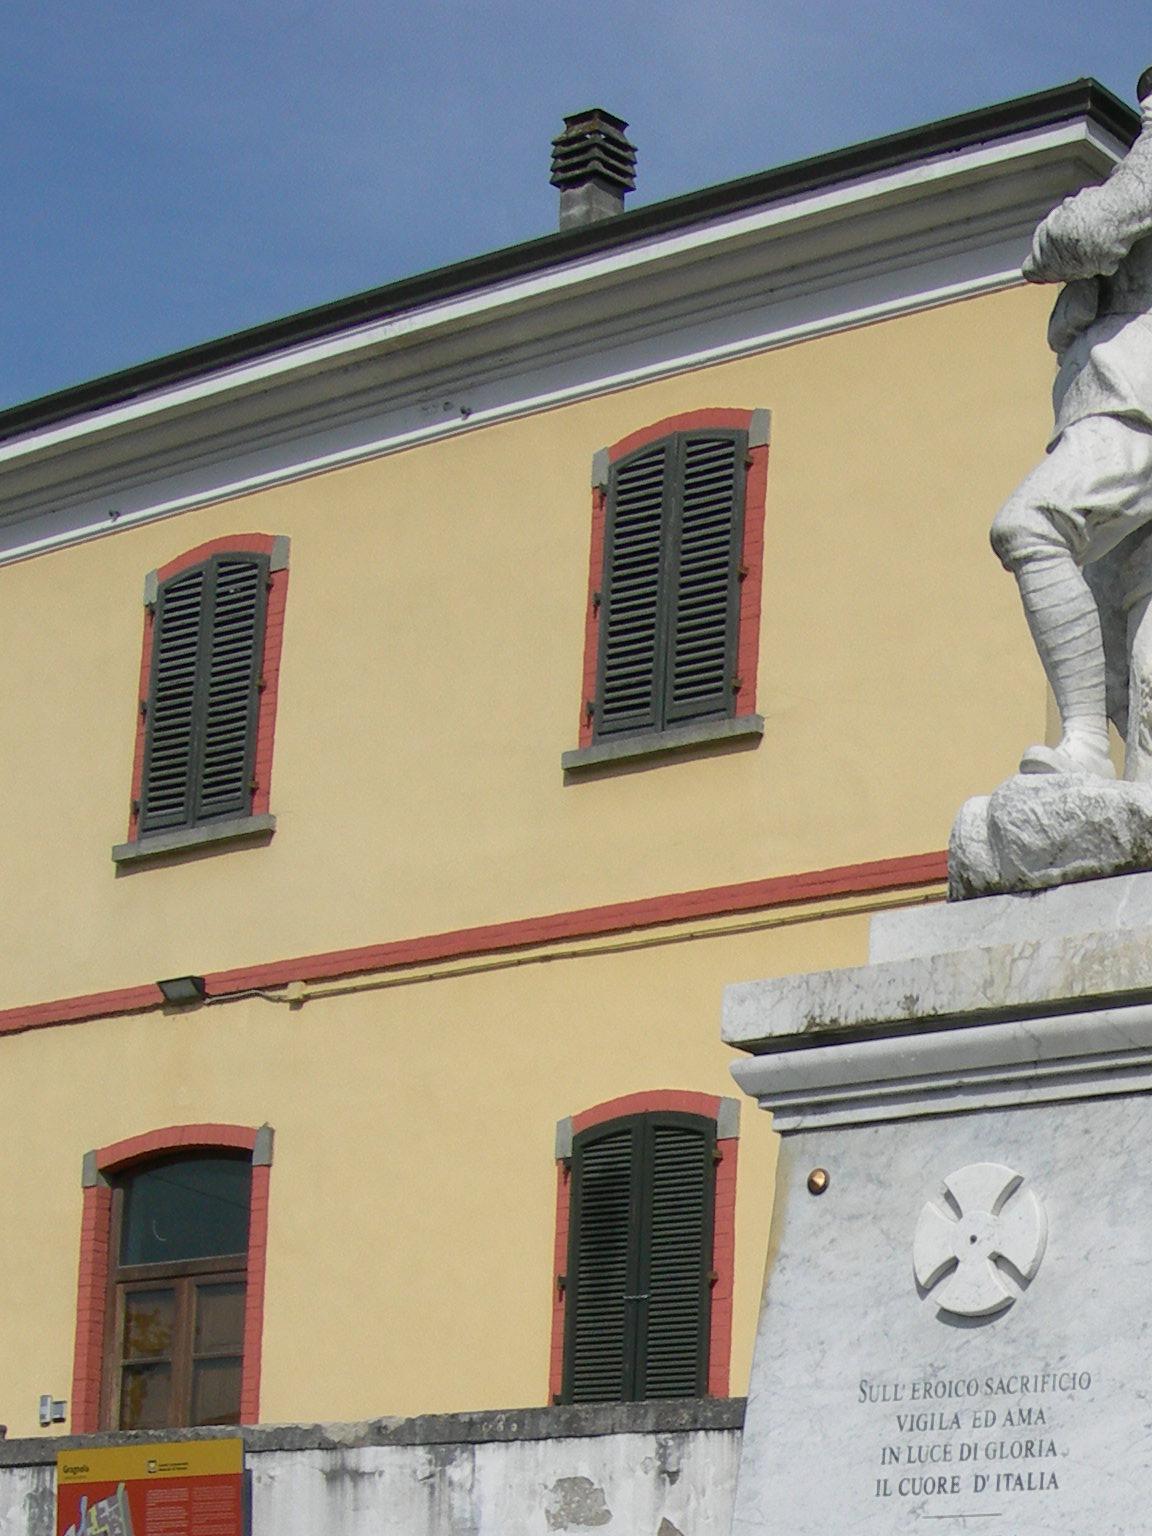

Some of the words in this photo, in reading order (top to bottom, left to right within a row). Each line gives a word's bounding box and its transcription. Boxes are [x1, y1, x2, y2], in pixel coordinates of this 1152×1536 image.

[984, 1371, 1092, 1396] SACRIFICIO
[896, 1411, 962, 1432] VIGILA
[972, 1410, 997, 1428] ED
[1003, 1407, 1047, 1427] AMA
[880, 1446, 901, 1465] IN
[906, 1443, 953, 1464] LUCE
[959, 1442, 979, 1462] DI
[875, 1478, 893, 1498] IL
[898, 1475, 961, 1497] CUORE
